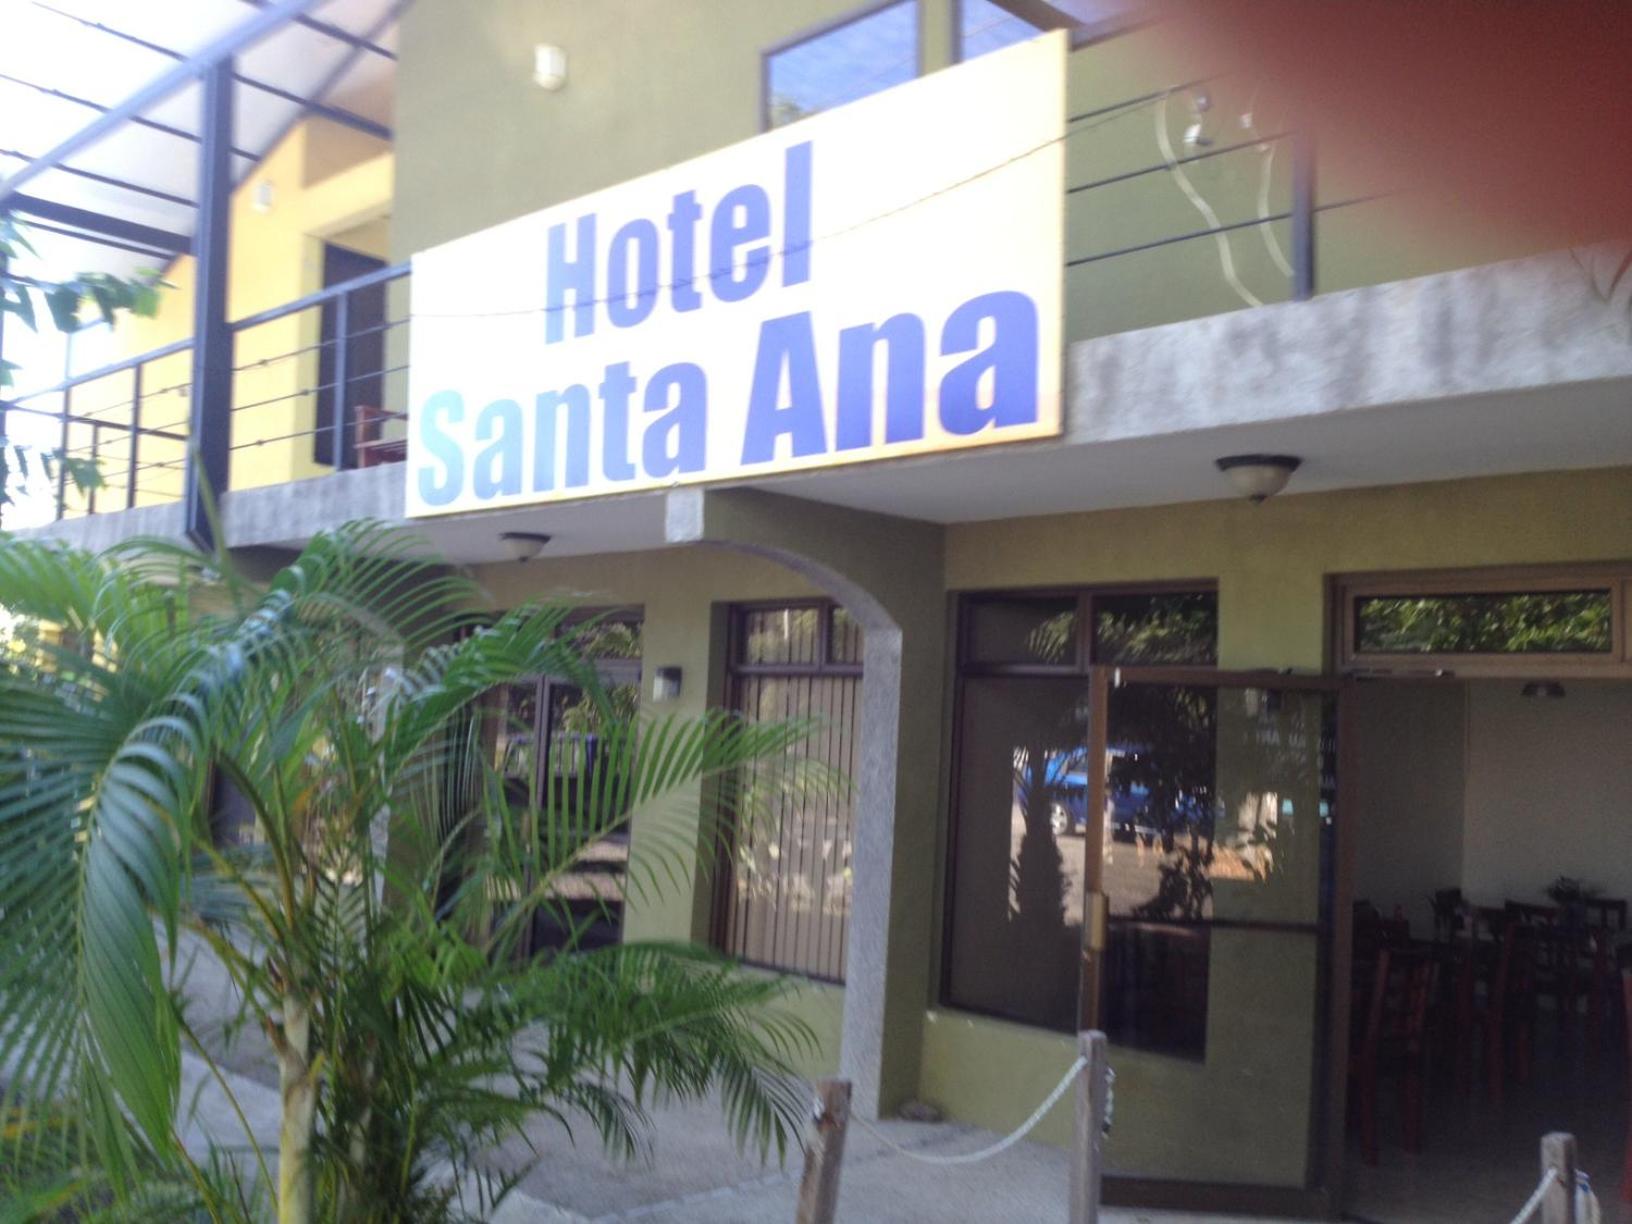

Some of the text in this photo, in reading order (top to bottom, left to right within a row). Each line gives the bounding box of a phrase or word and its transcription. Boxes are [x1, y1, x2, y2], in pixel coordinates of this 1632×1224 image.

[545, 140, 812, 342] Hotel
[418, 289, 1039, 506] Santa Ana
